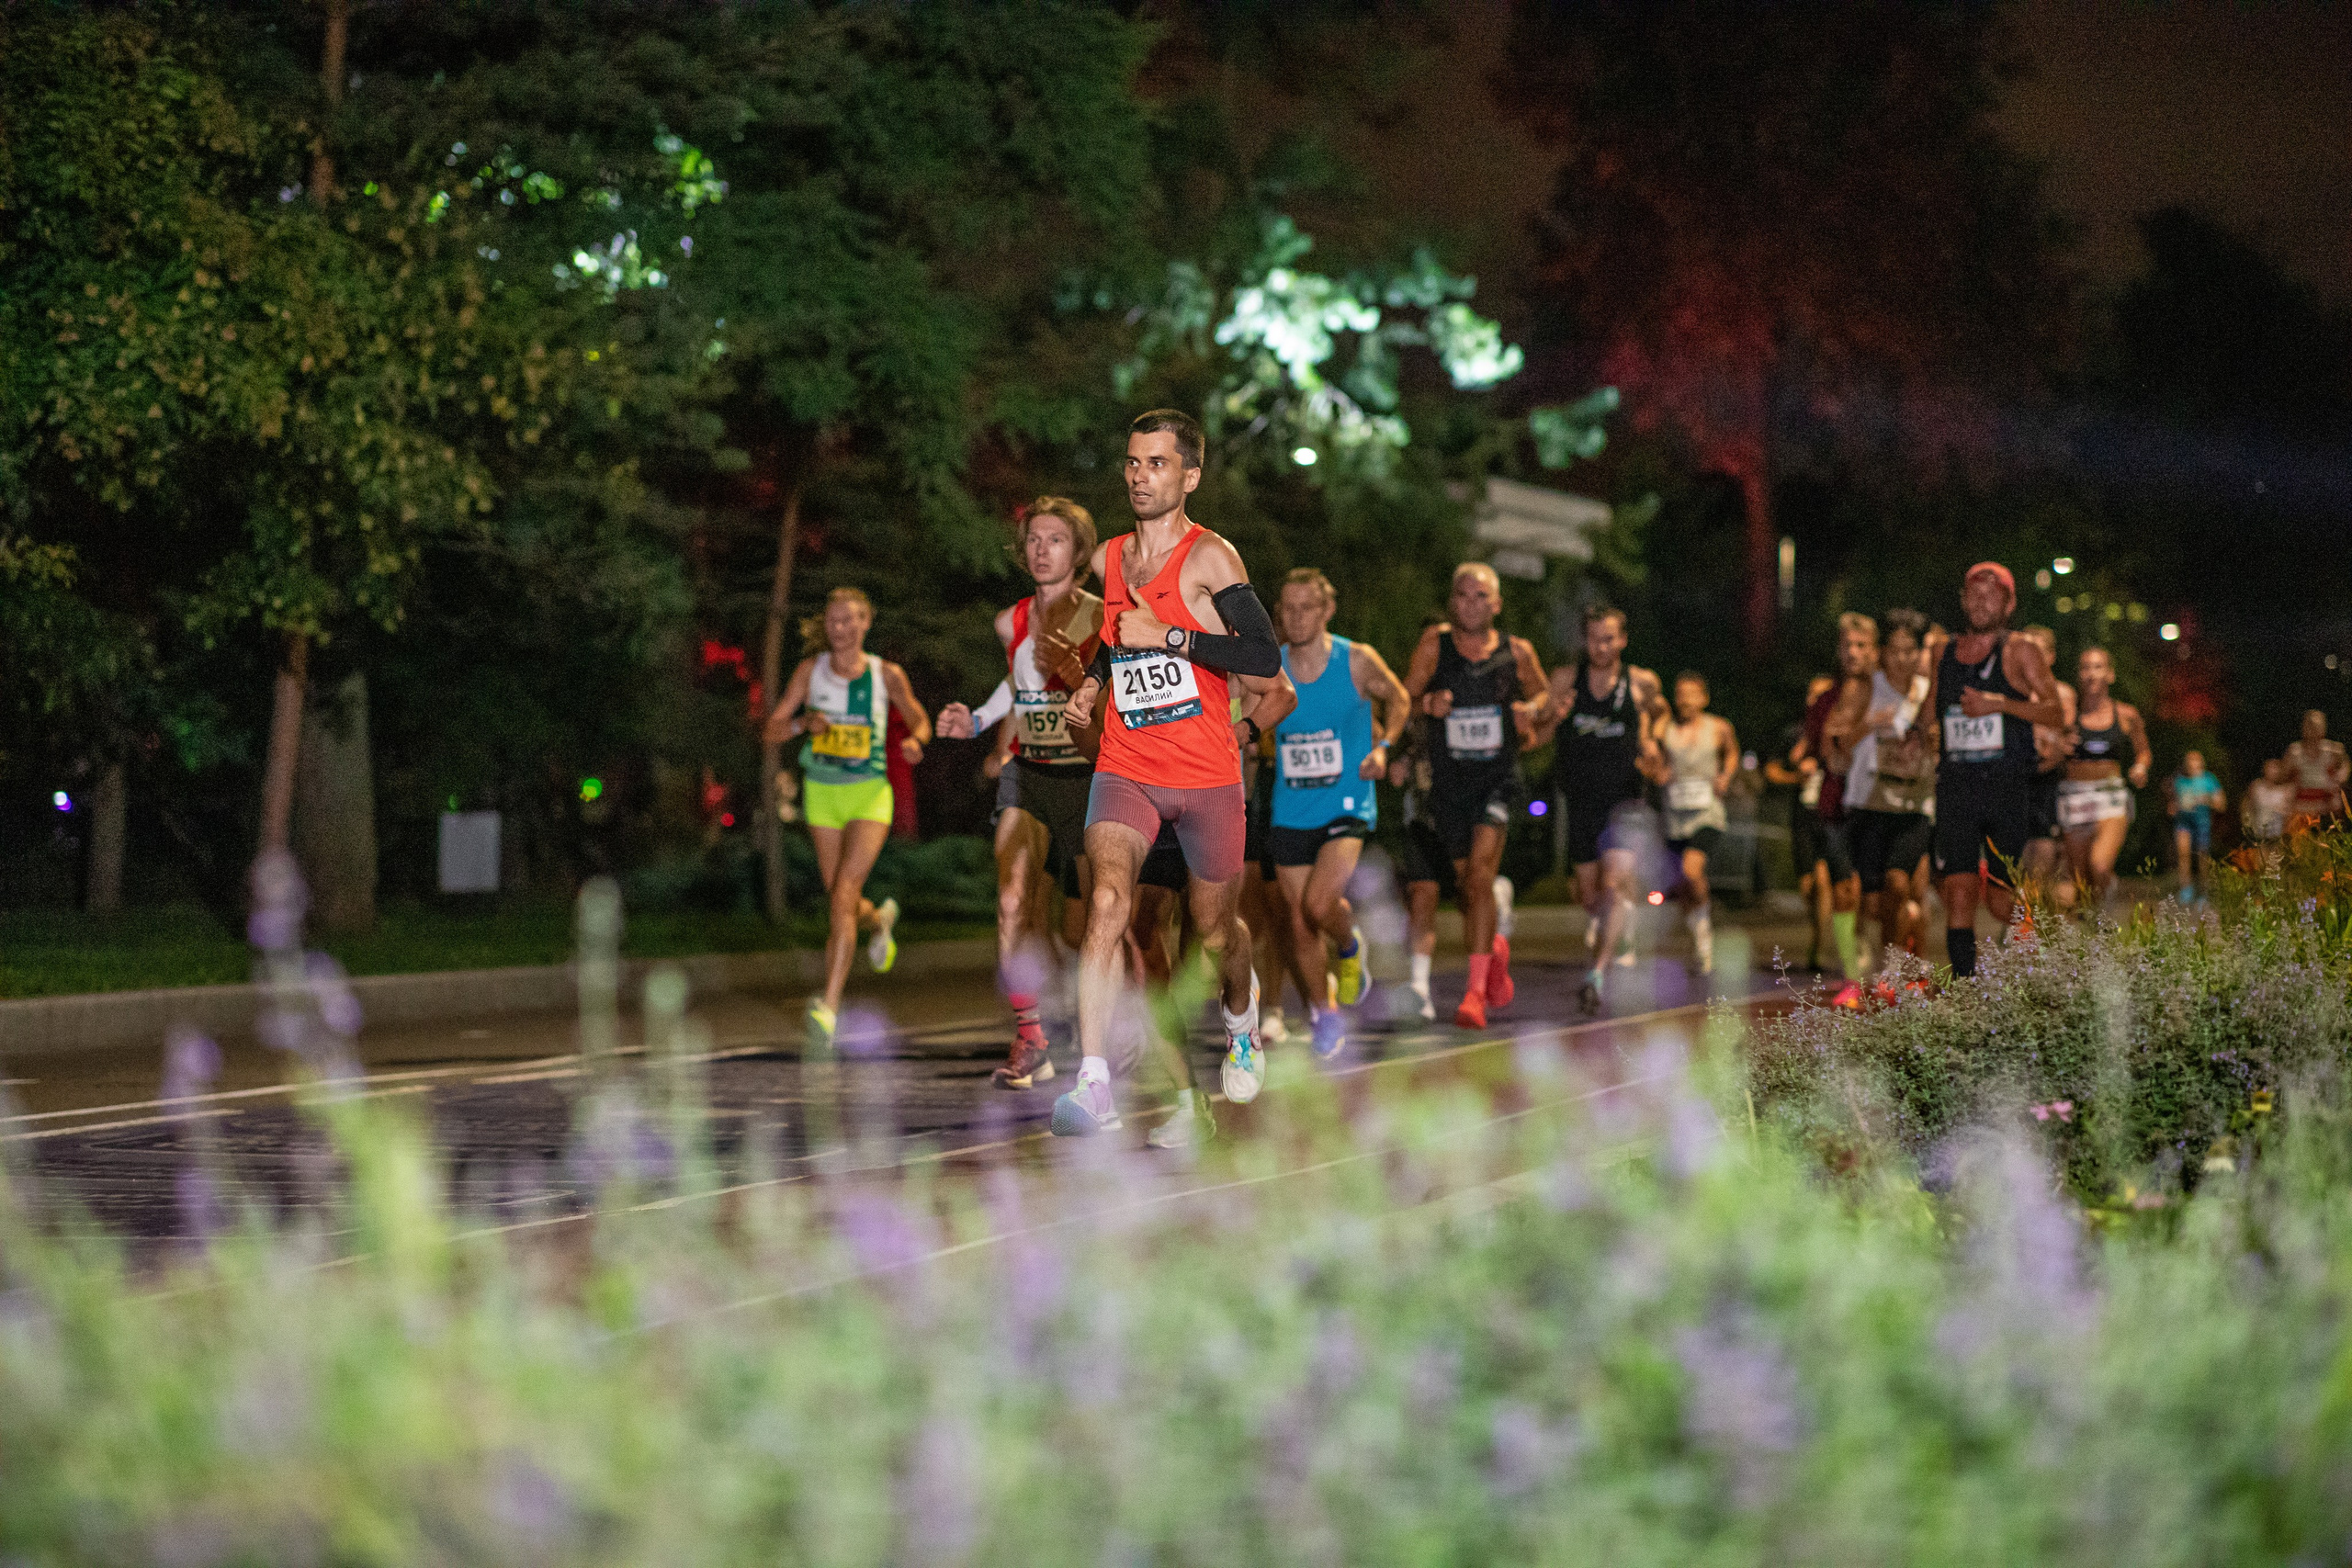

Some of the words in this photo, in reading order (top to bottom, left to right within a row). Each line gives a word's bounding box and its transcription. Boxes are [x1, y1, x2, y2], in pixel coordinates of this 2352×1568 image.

[1123, 660, 1182, 695] 2150
[1135, 690, 1173, 705] ВАСИЛИЙ
[1290, 746, 1335, 768] 5018
